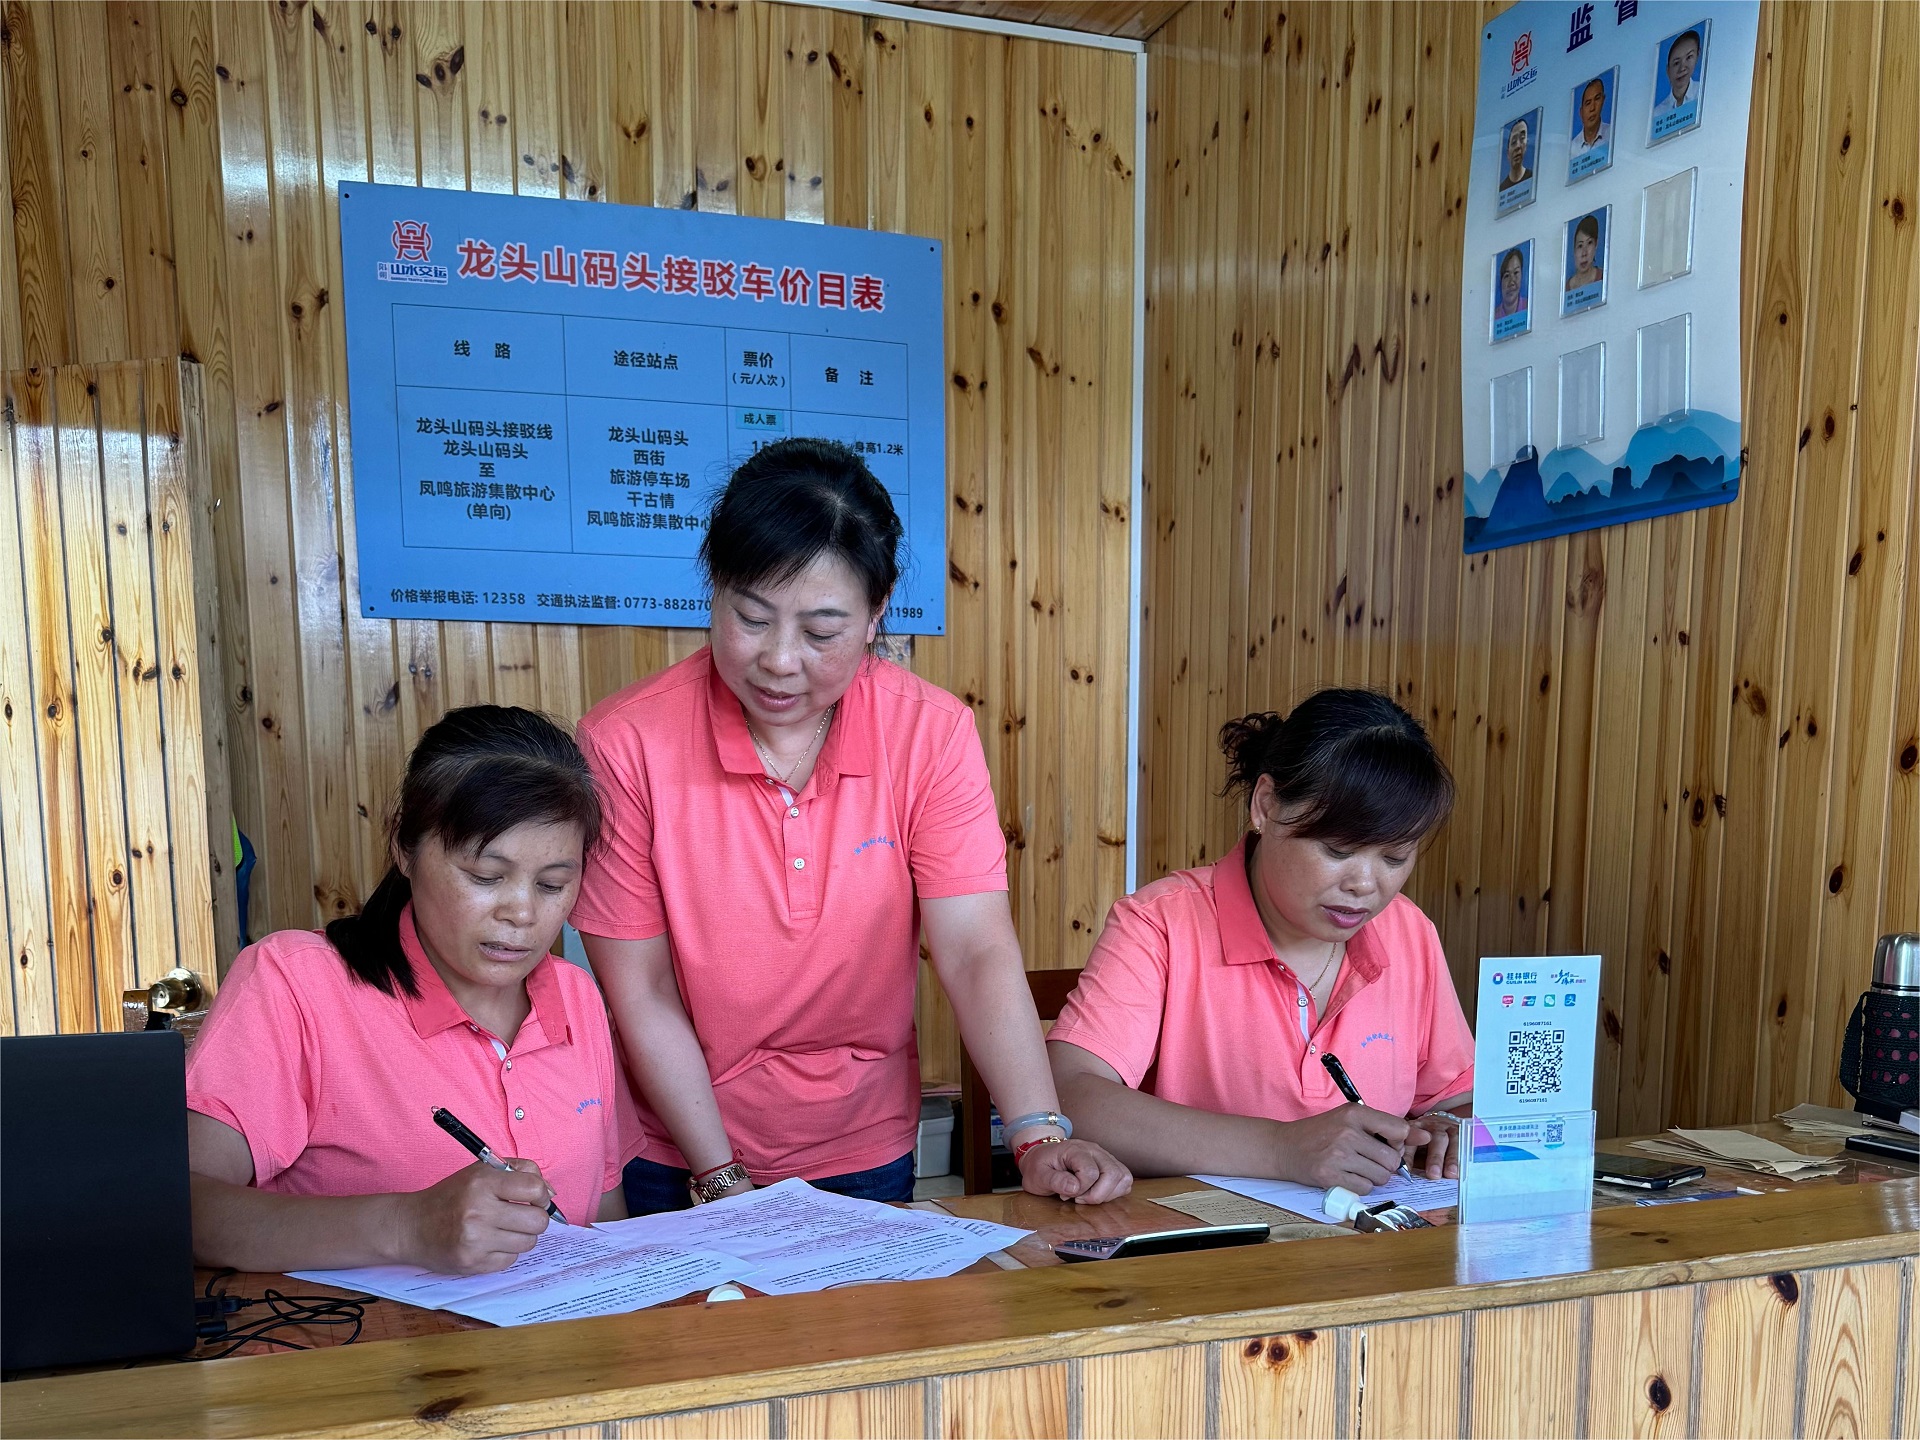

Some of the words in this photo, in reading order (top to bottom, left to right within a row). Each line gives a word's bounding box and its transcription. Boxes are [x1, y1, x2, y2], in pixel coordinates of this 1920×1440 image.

[391, 264, 447, 278] 山水交运
[457, 239, 885, 312] 龙头山码头接驳车价目表
[613, 350, 679, 371] 途径站点
[743, 350, 774, 368] 票价
[416, 417, 553, 441] 龙头山码头接驳线
[743, 413, 777, 426] 成人票
[609, 426, 689, 447] 龙头山码头
[443, 440, 529, 460] 龙头山码头
[633, 449, 666, 466] 西街
[478, 462, 496, 478] 至
[609, 468, 690, 489] 旅游停车场
[419, 480, 556, 502] 凤鸣旅游集散中心
[466, 503, 511, 521] (单向)
[482, 592, 526, 605] 12358
